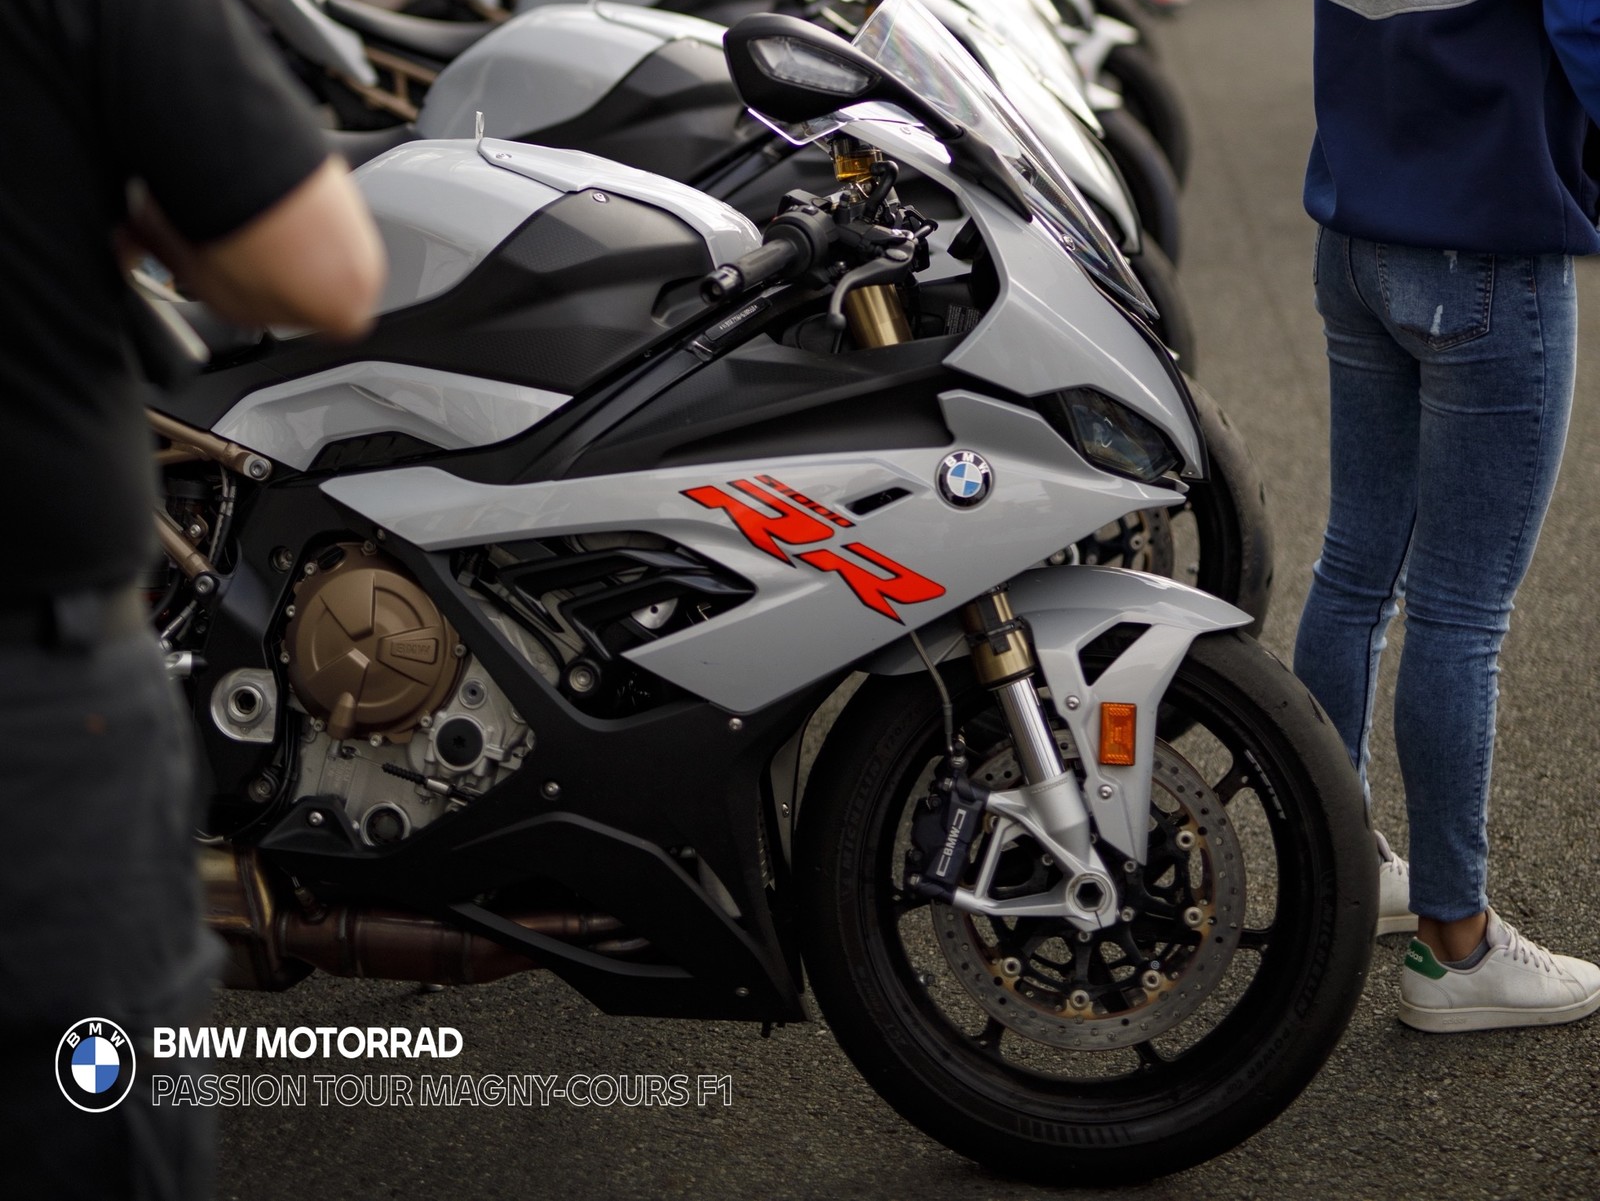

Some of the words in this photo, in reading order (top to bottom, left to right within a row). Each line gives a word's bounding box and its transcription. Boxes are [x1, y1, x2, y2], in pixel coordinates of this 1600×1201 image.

[944, 452, 989, 474] BMW
[841, 753, 882, 870] MICHELIN
[943, 824, 962, 858] BMW
